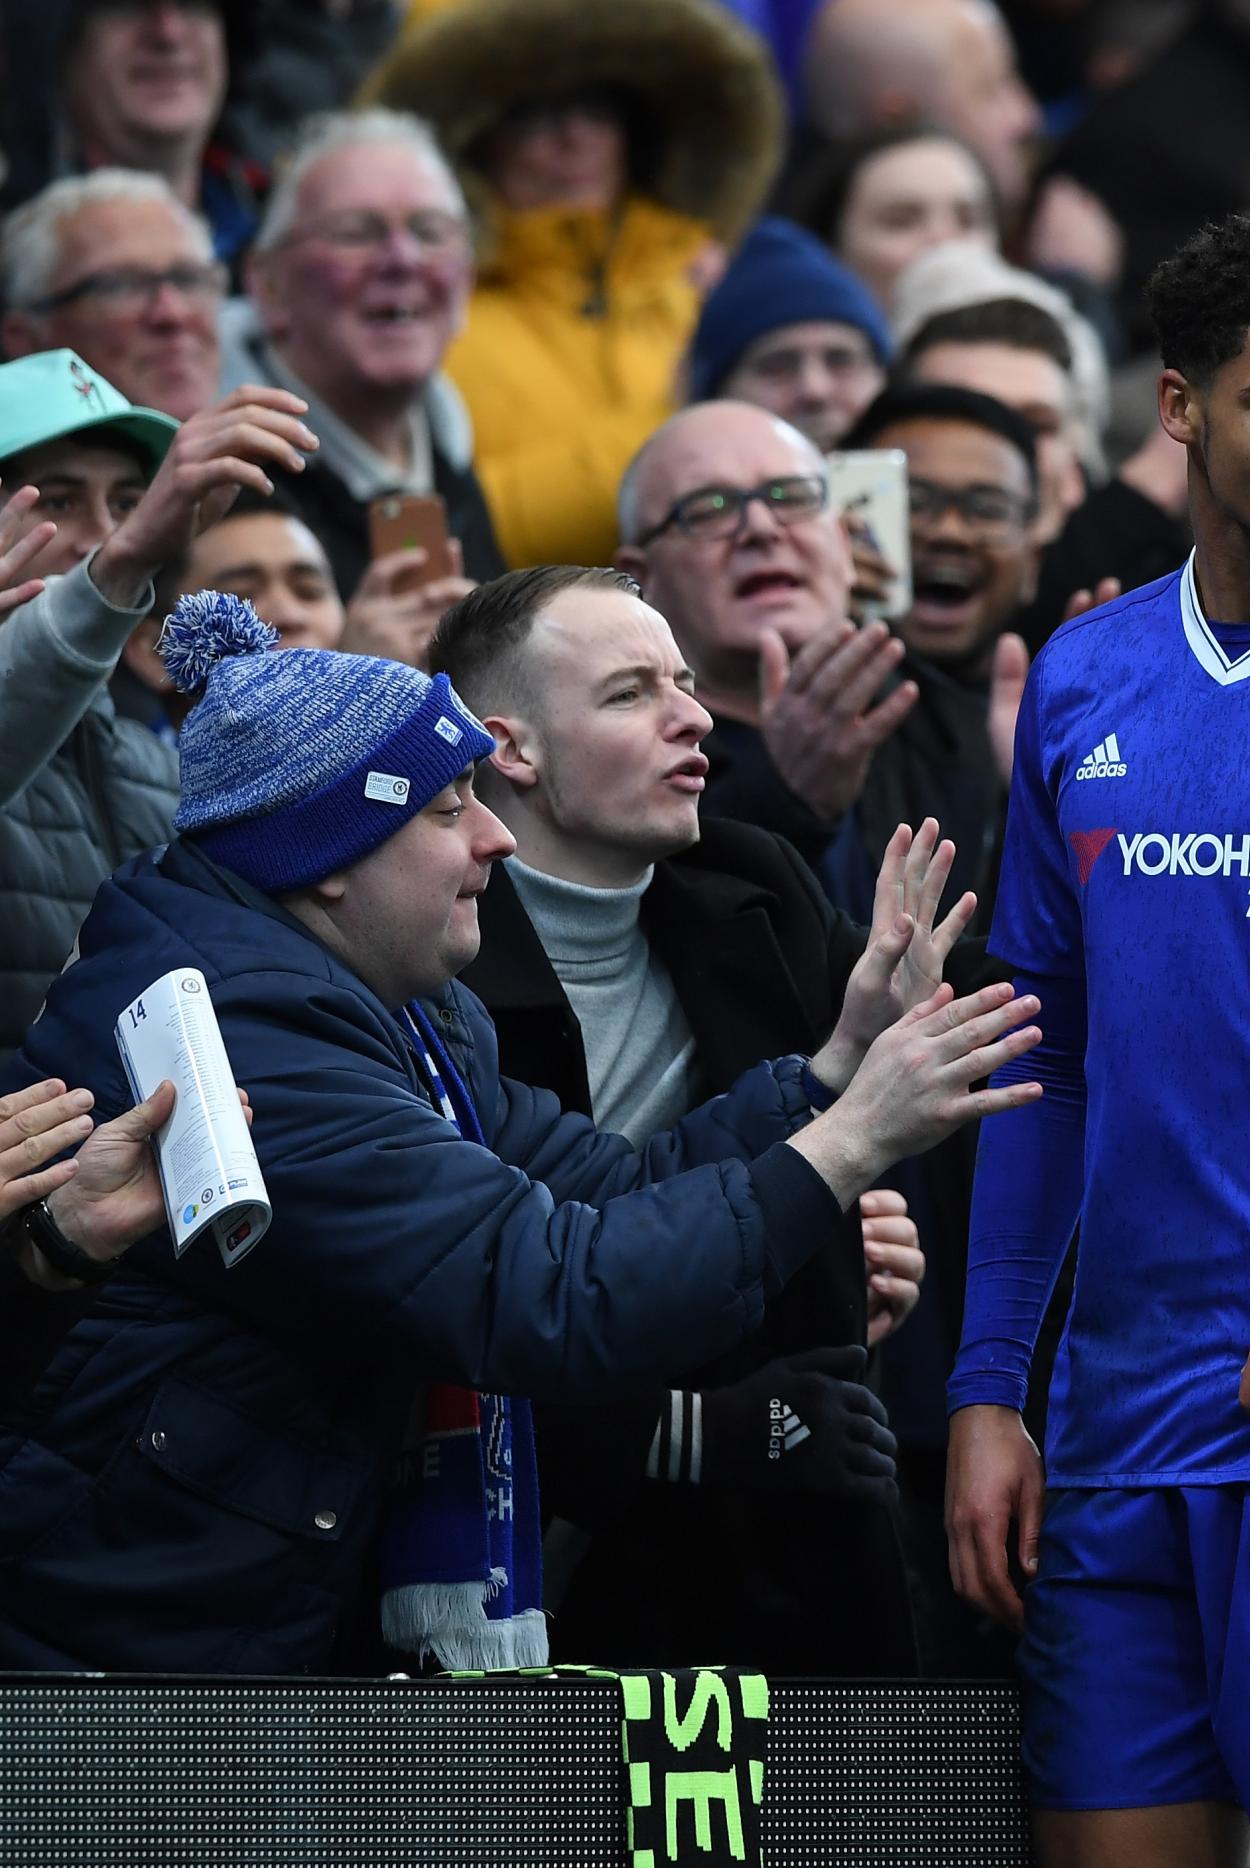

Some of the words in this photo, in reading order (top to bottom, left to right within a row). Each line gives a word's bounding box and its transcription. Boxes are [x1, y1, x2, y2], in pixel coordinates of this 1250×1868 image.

[1076, 761, 1128, 781] adidas
[128, 999, 147, 1029] 14
[768, 1398, 786, 1460] adidas
